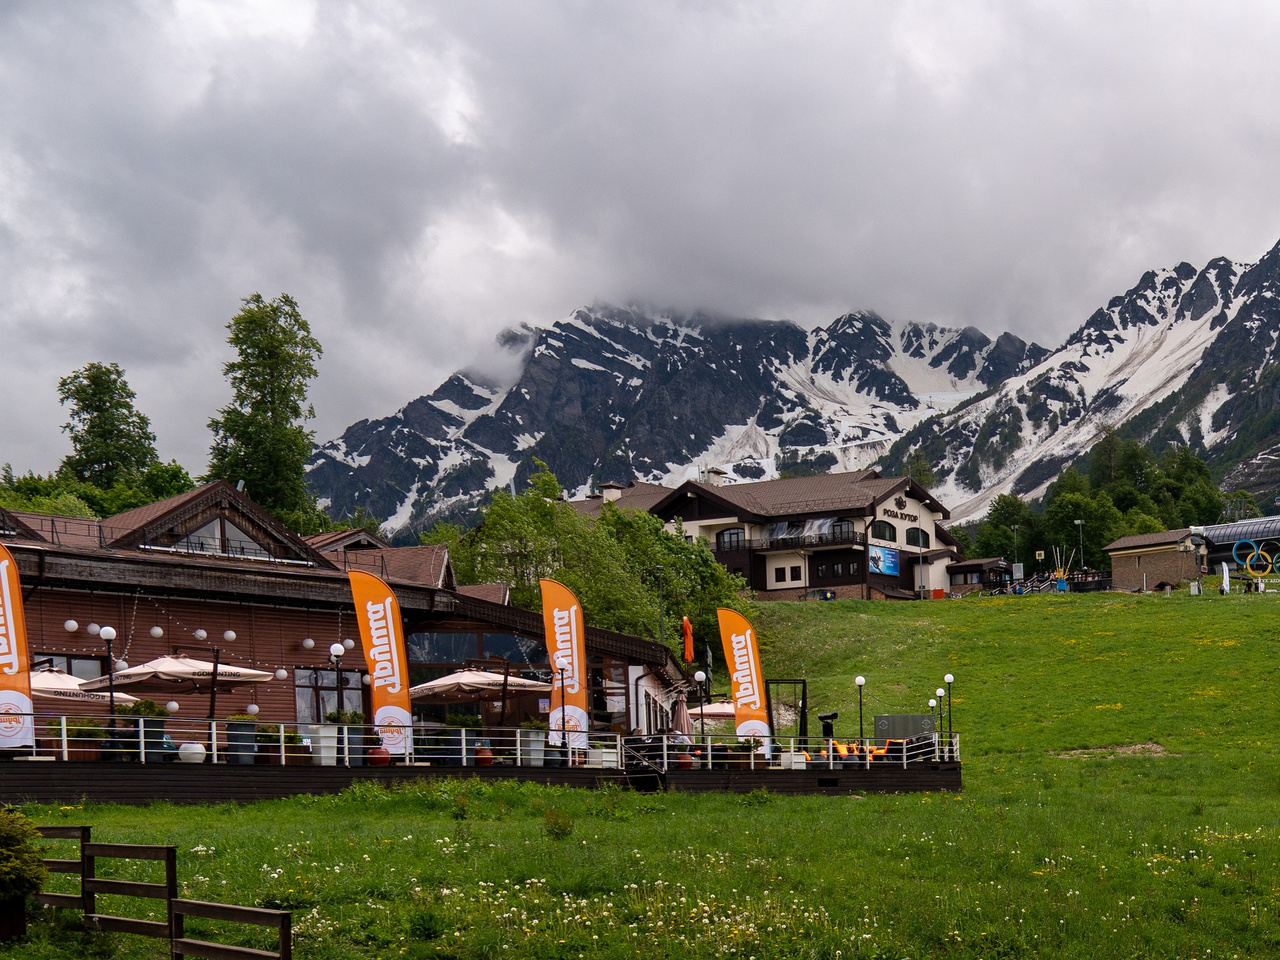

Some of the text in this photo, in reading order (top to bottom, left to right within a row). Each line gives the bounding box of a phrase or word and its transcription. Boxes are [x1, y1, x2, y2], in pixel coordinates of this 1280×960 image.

[883, 508, 919, 522] РОЗА ХУТОР
[53, 690, 106, 700] #GOHUNTING
